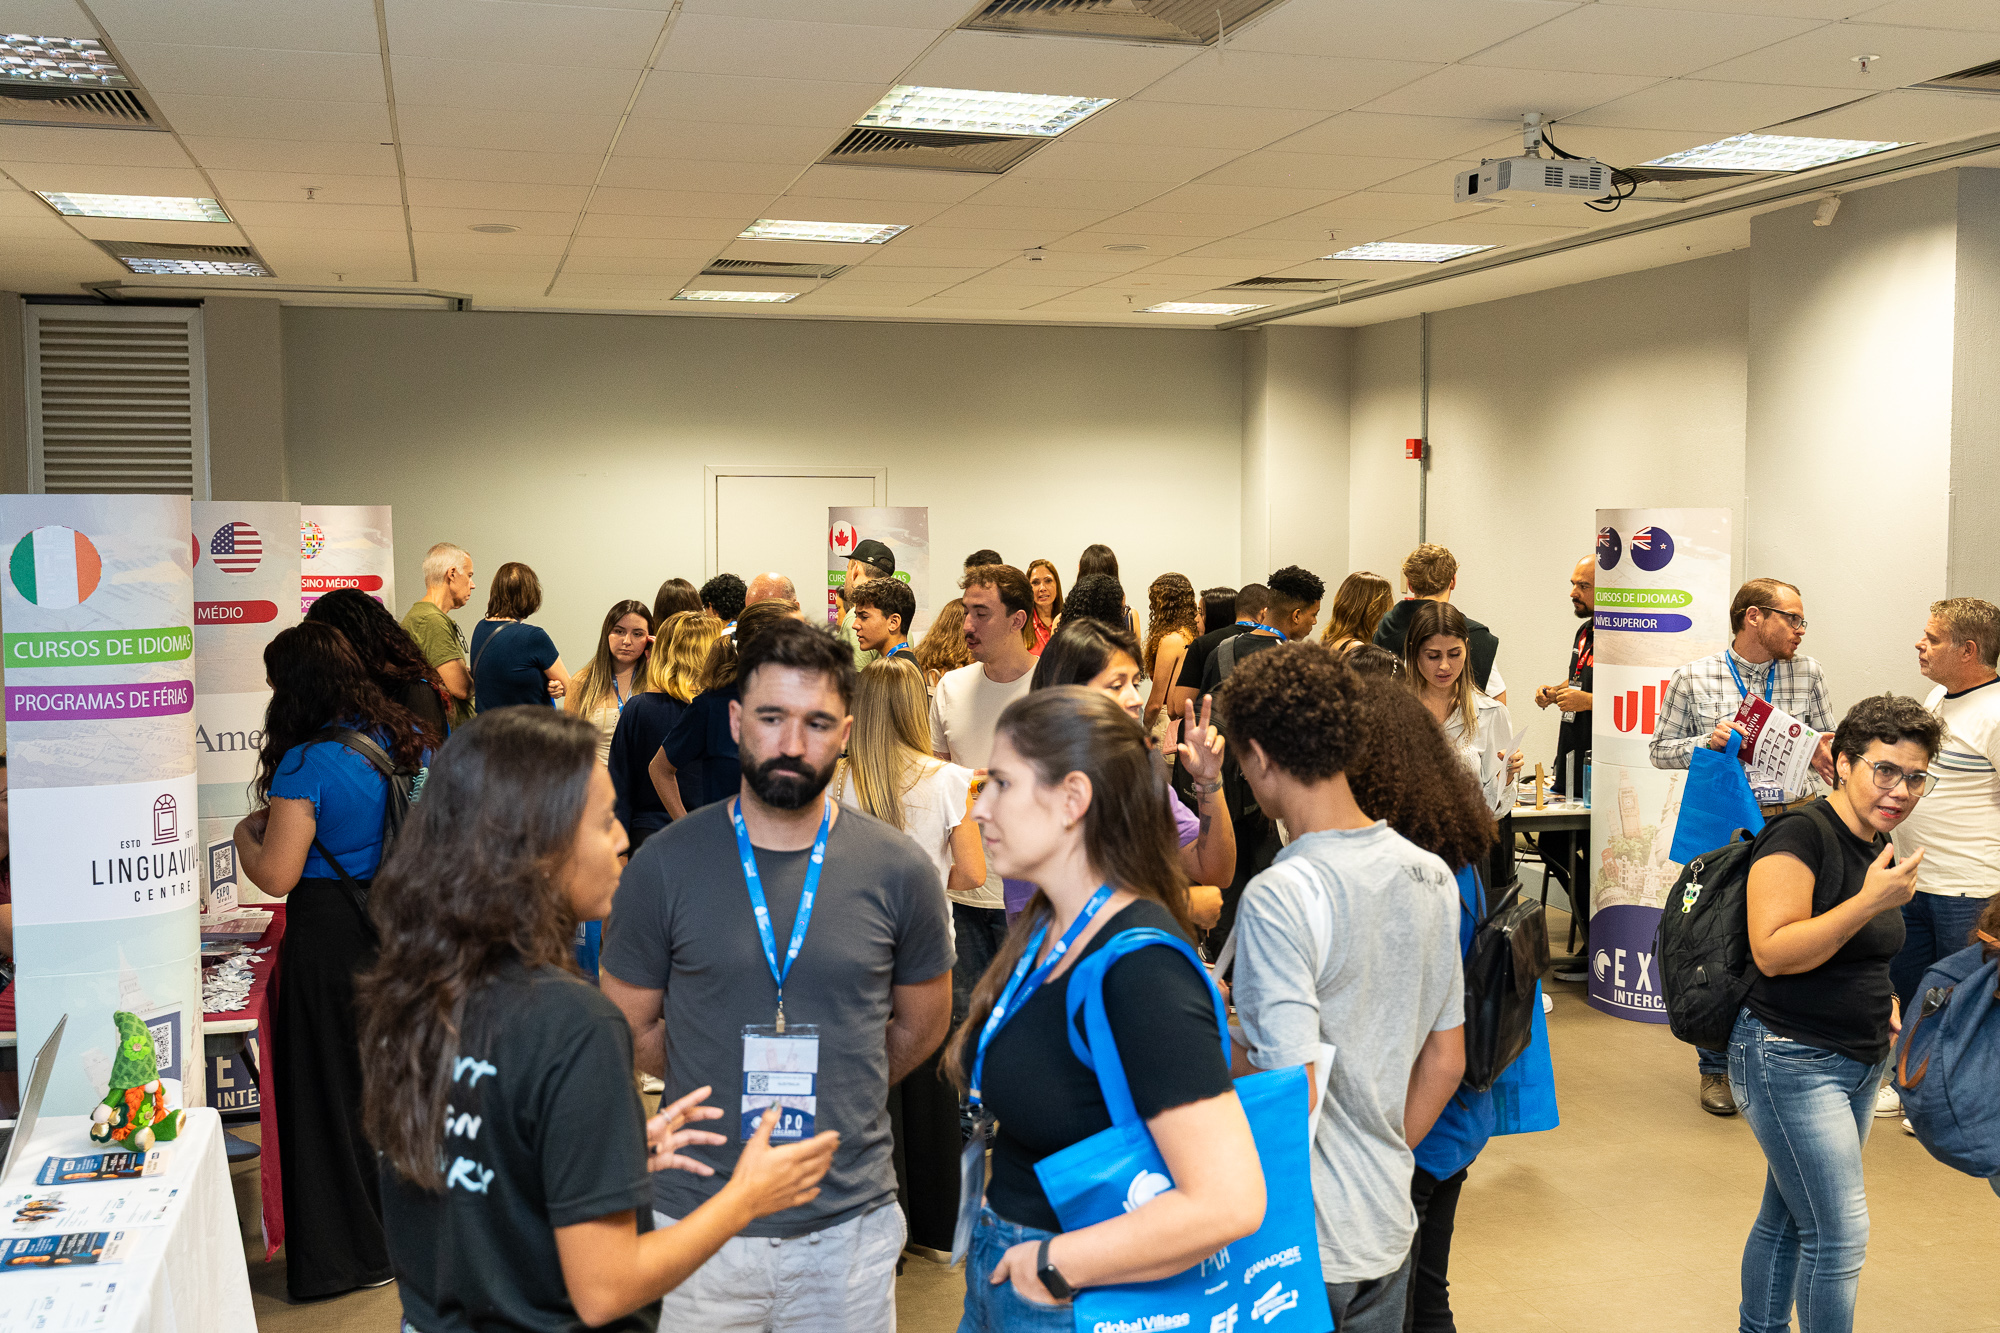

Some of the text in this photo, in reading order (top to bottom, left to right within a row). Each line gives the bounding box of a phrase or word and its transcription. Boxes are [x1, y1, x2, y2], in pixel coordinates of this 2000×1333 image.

[325, 577, 360, 588] MÉDIO
[1595, 591, 1685, 604] CURSOS DE IDIOMAS
[197, 605, 244, 620] MÉDIO
[1595, 614, 1658, 629] NÍVEL SUPERIOR
[13, 633, 191, 659] CURSOS DE IDIOMAS
[15, 685, 188, 712] PROGRAMAS DE FÉRIAS
[196, 723, 269, 753] Ame
[120, 839, 141, 849] ESTD
[134, 880, 191, 903] CENTRE
[216, 884, 230, 900] EXPO
[217, 1087, 260, 1108] INTE
[1093, 1312, 1191, 1333] Global Village
